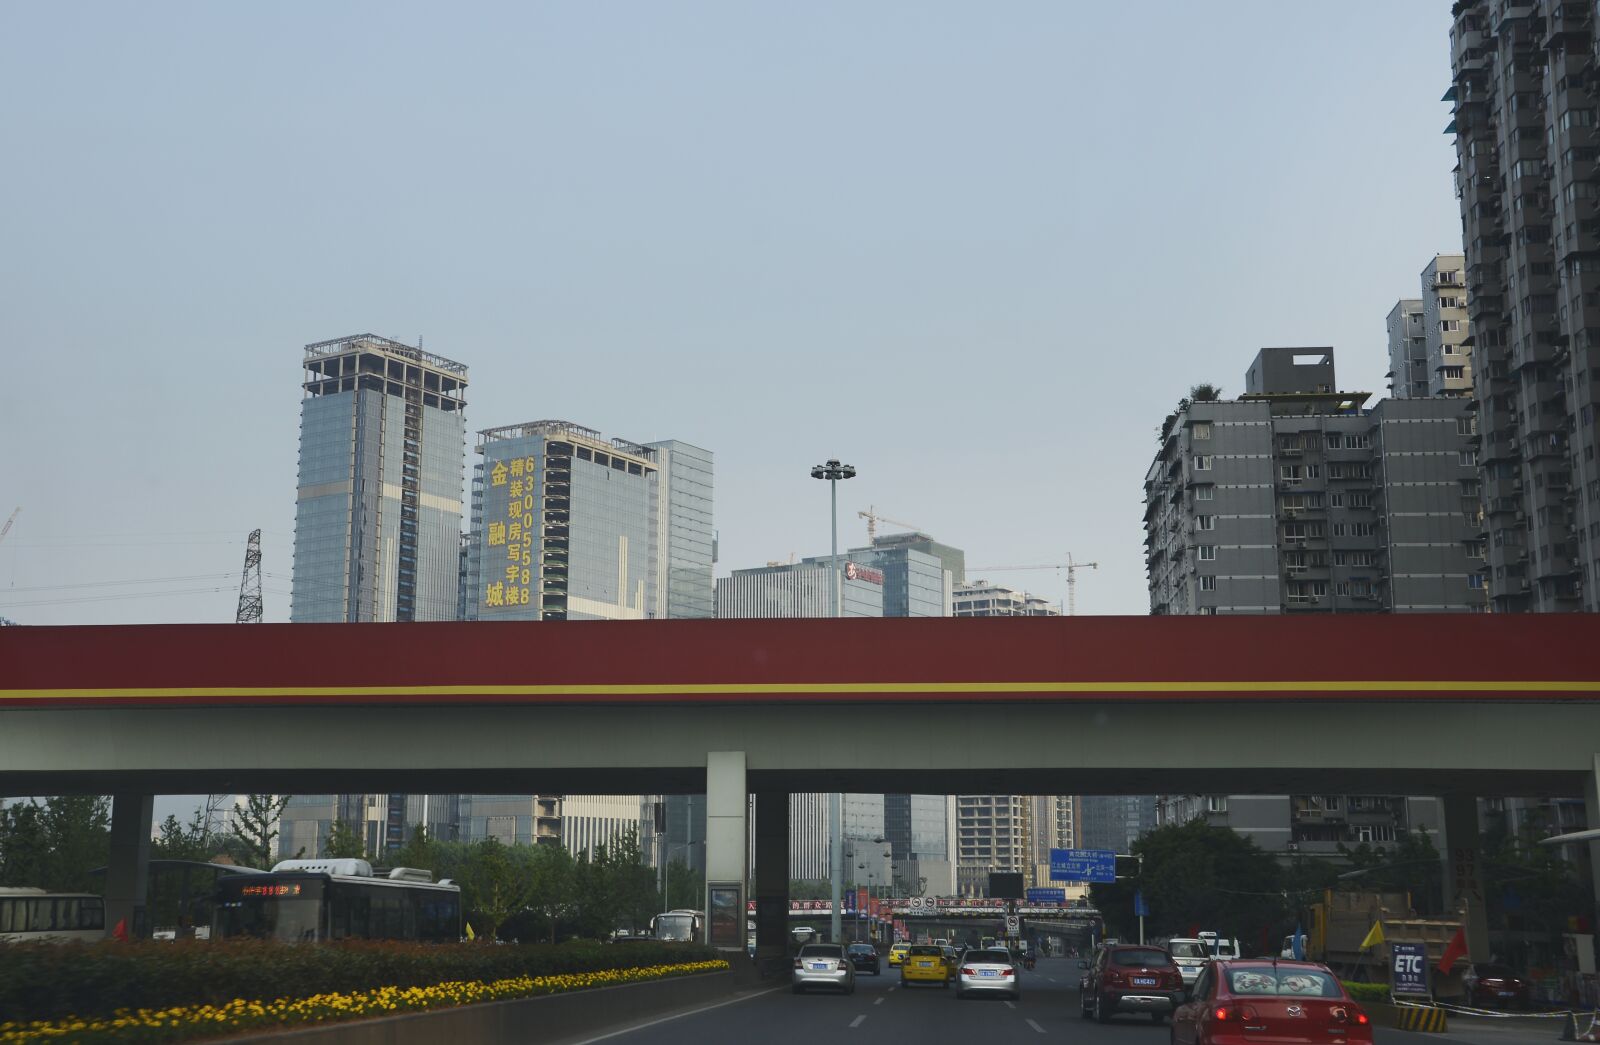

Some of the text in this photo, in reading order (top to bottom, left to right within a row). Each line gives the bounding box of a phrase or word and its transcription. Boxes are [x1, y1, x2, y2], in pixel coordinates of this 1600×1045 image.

[486, 460, 508, 607] 金融城
[505, 458, 525, 606] 精装现房写字楼
[520, 456, 535, 605] 63005588
[1455, 848, 1474, 862] 93
[1455, 864, 1474, 877] 97
[1395, 954, 1424, 974] ETC
